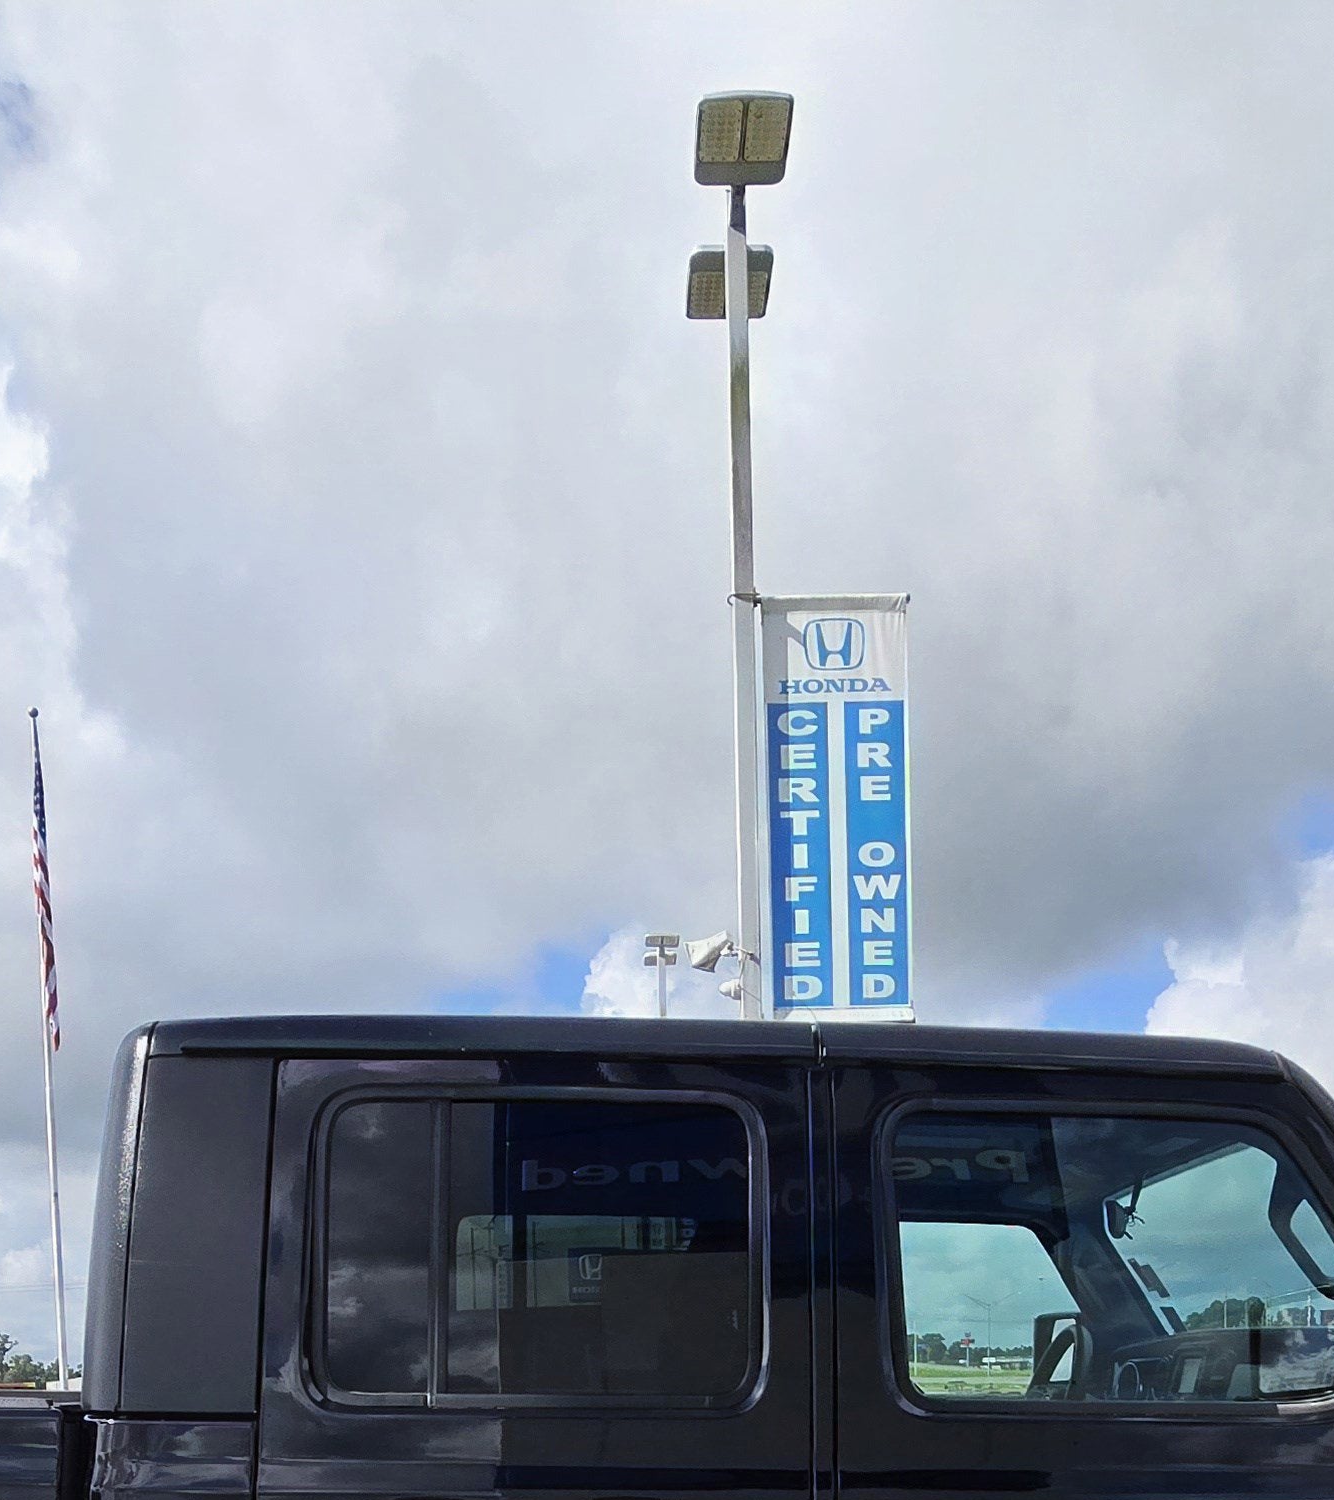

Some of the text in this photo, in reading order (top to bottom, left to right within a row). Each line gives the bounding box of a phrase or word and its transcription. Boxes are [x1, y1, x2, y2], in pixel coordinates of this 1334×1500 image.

[778, 677, 892, 696] HONDA
[777, 709, 824, 1000] CERTIFIED
[853, 707, 902, 1000] PRE OWNED
